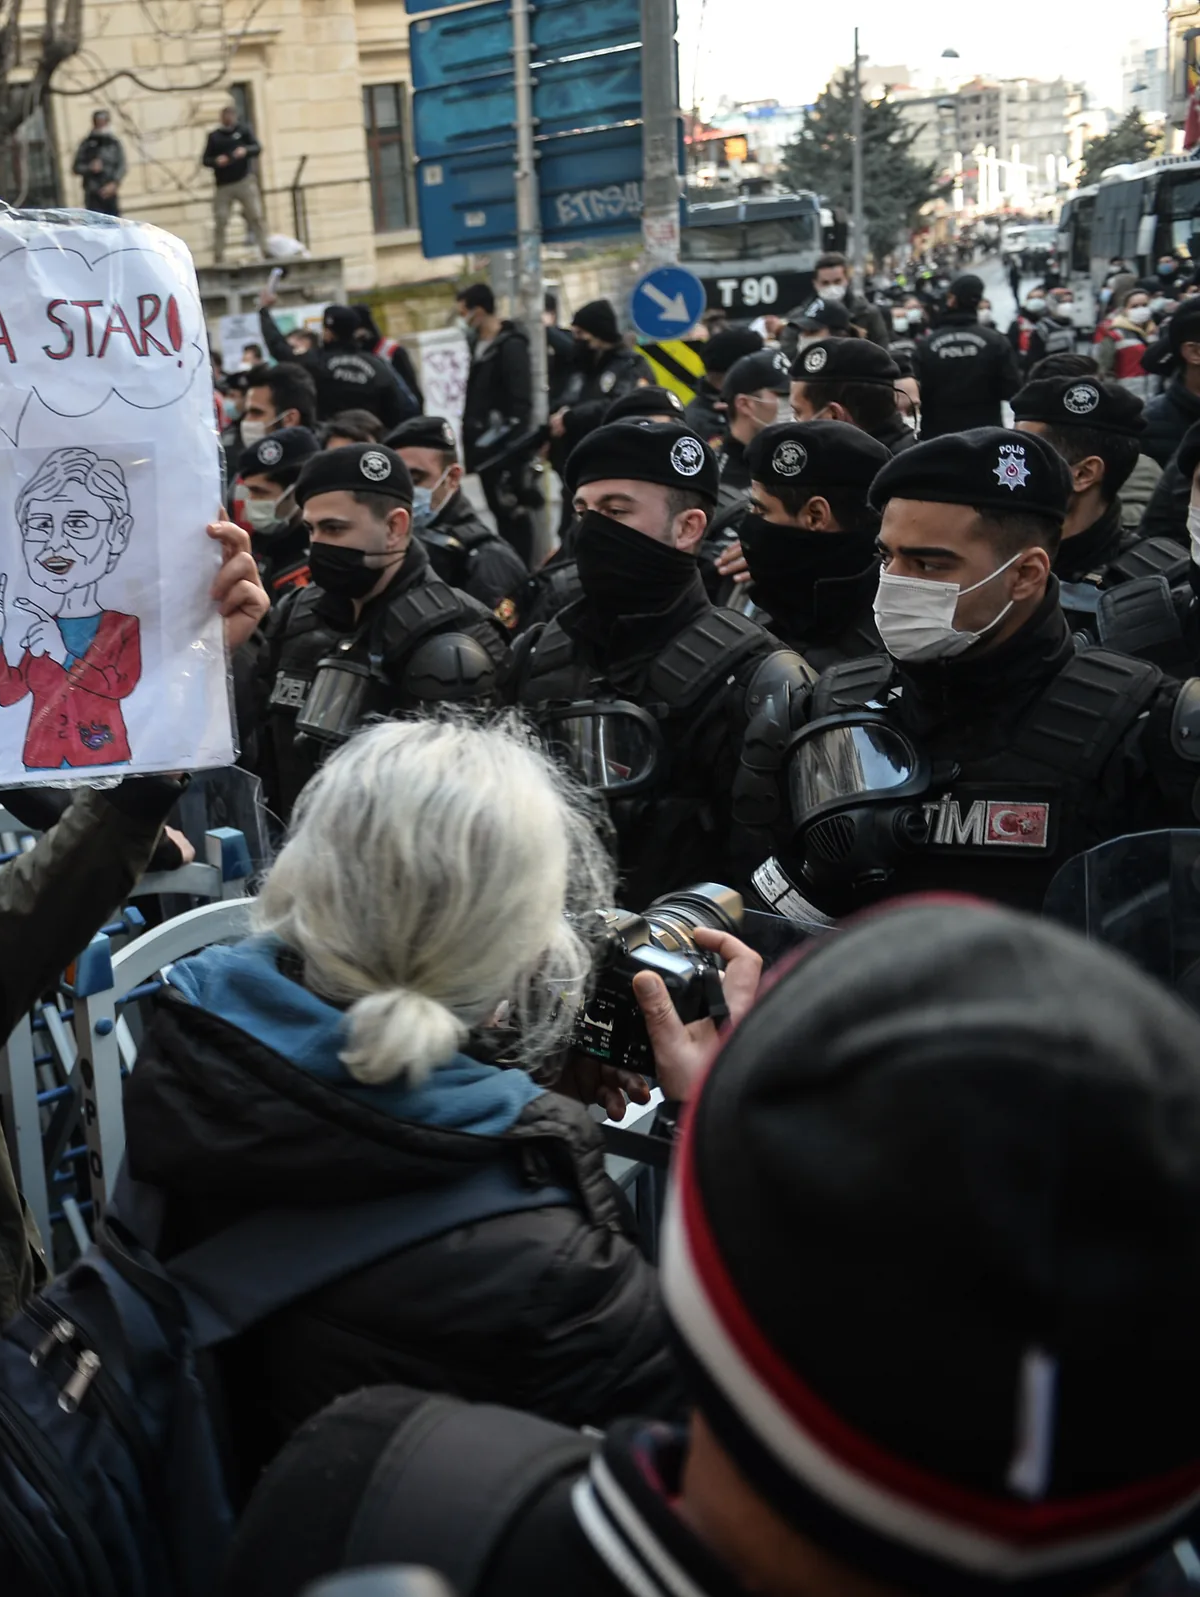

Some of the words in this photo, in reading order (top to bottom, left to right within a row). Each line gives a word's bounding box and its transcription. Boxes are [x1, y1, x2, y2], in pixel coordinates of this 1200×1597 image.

[717, 279, 739, 307] T
[741, 276, 778, 306] 90
[41, 293, 184, 368] STAR!
